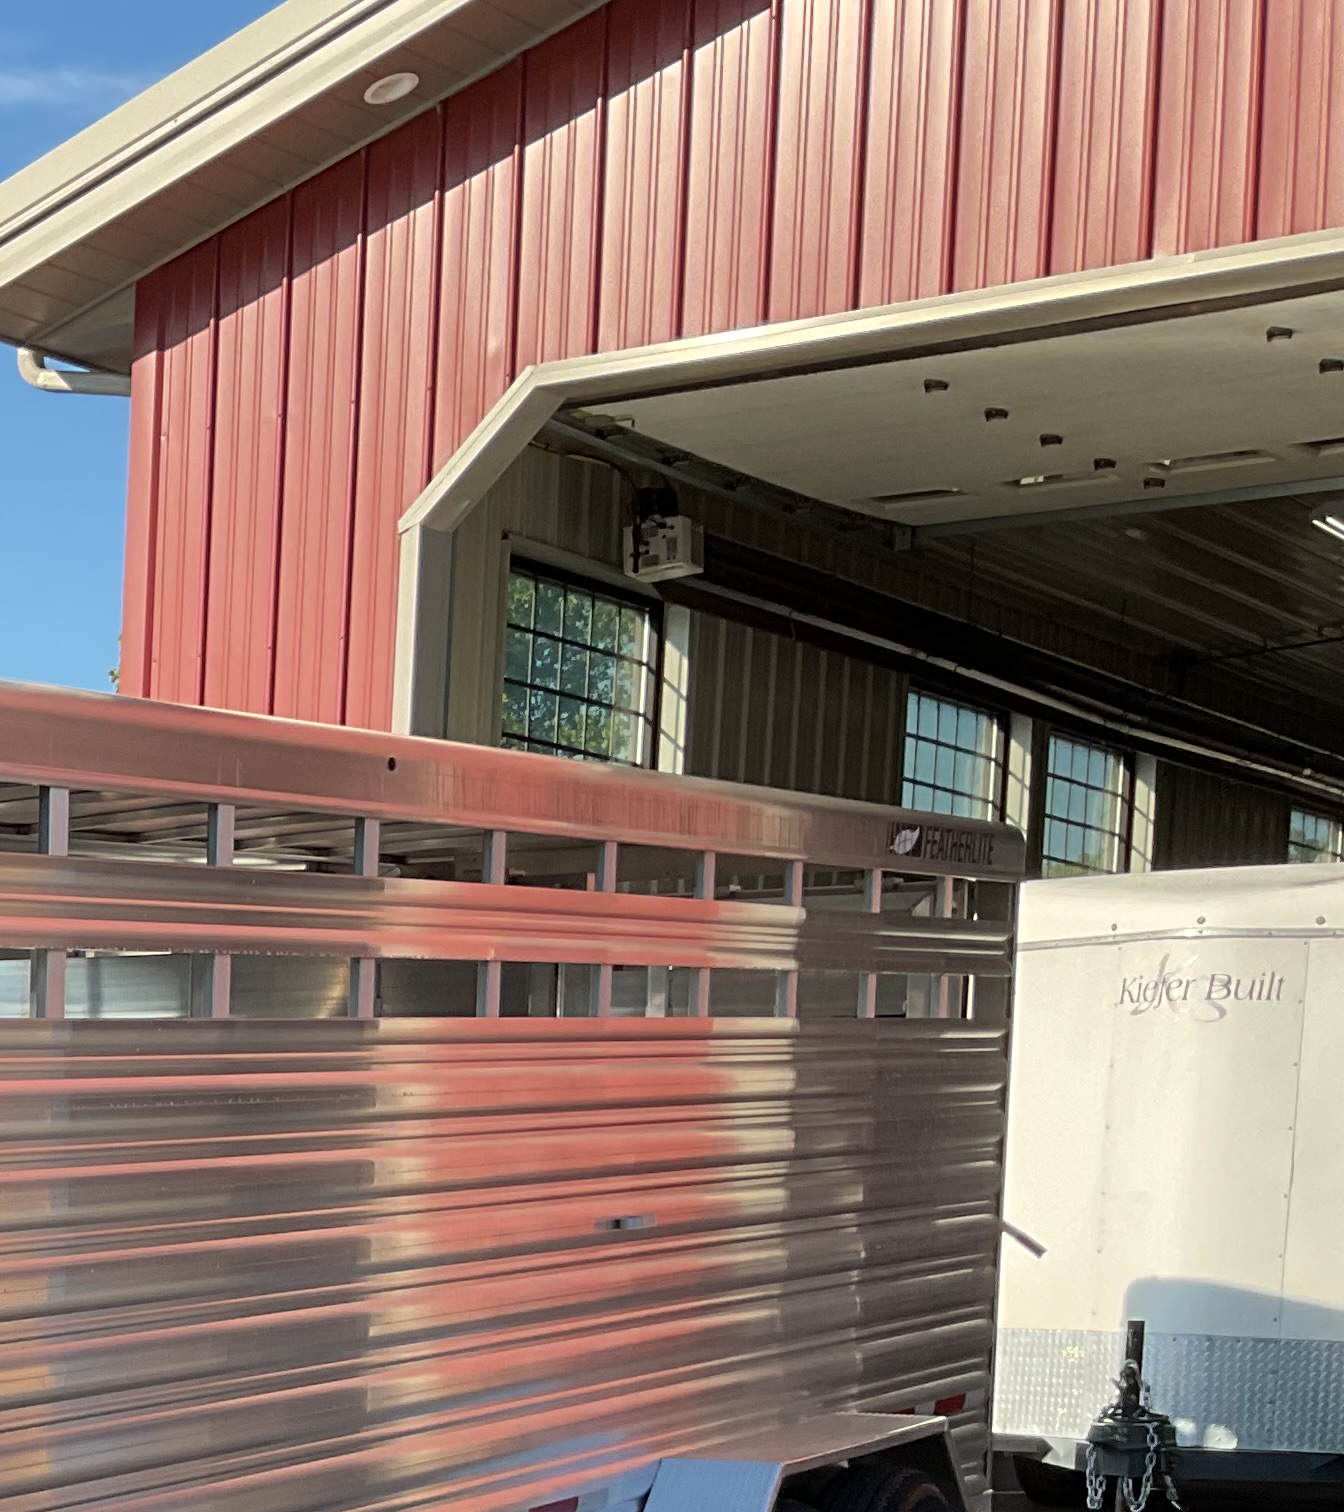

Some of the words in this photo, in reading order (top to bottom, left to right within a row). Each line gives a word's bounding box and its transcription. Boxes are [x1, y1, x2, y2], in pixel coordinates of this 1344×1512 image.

[923, 825, 994, 866] FEATHERLITE
[1119, 969, 1197, 1010] Kiefer
[1204, 970, 1286, 1002] Built
